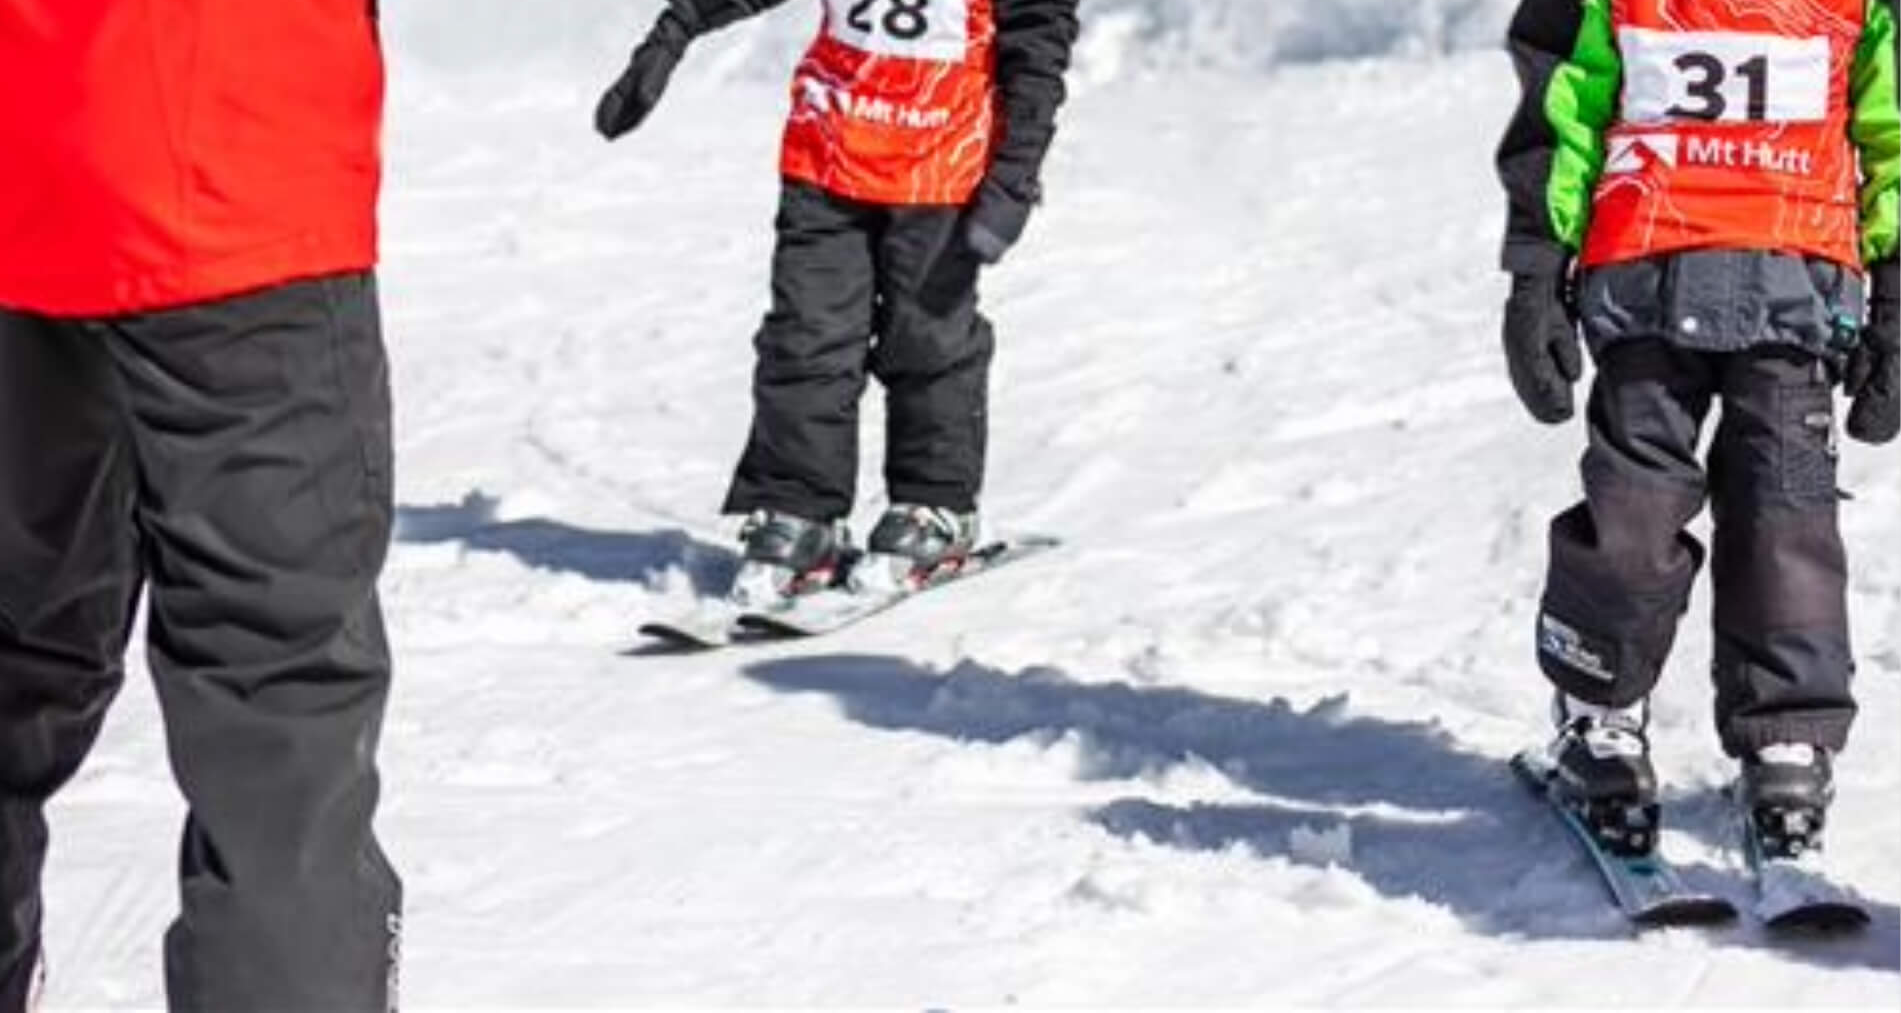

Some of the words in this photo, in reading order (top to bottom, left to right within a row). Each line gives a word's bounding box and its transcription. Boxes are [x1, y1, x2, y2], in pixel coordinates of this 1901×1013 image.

[1664, 51, 1769, 122] 31
[1686, 135, 1736, 167] Mt
[1741, 139, 1812, 175] Hutt
